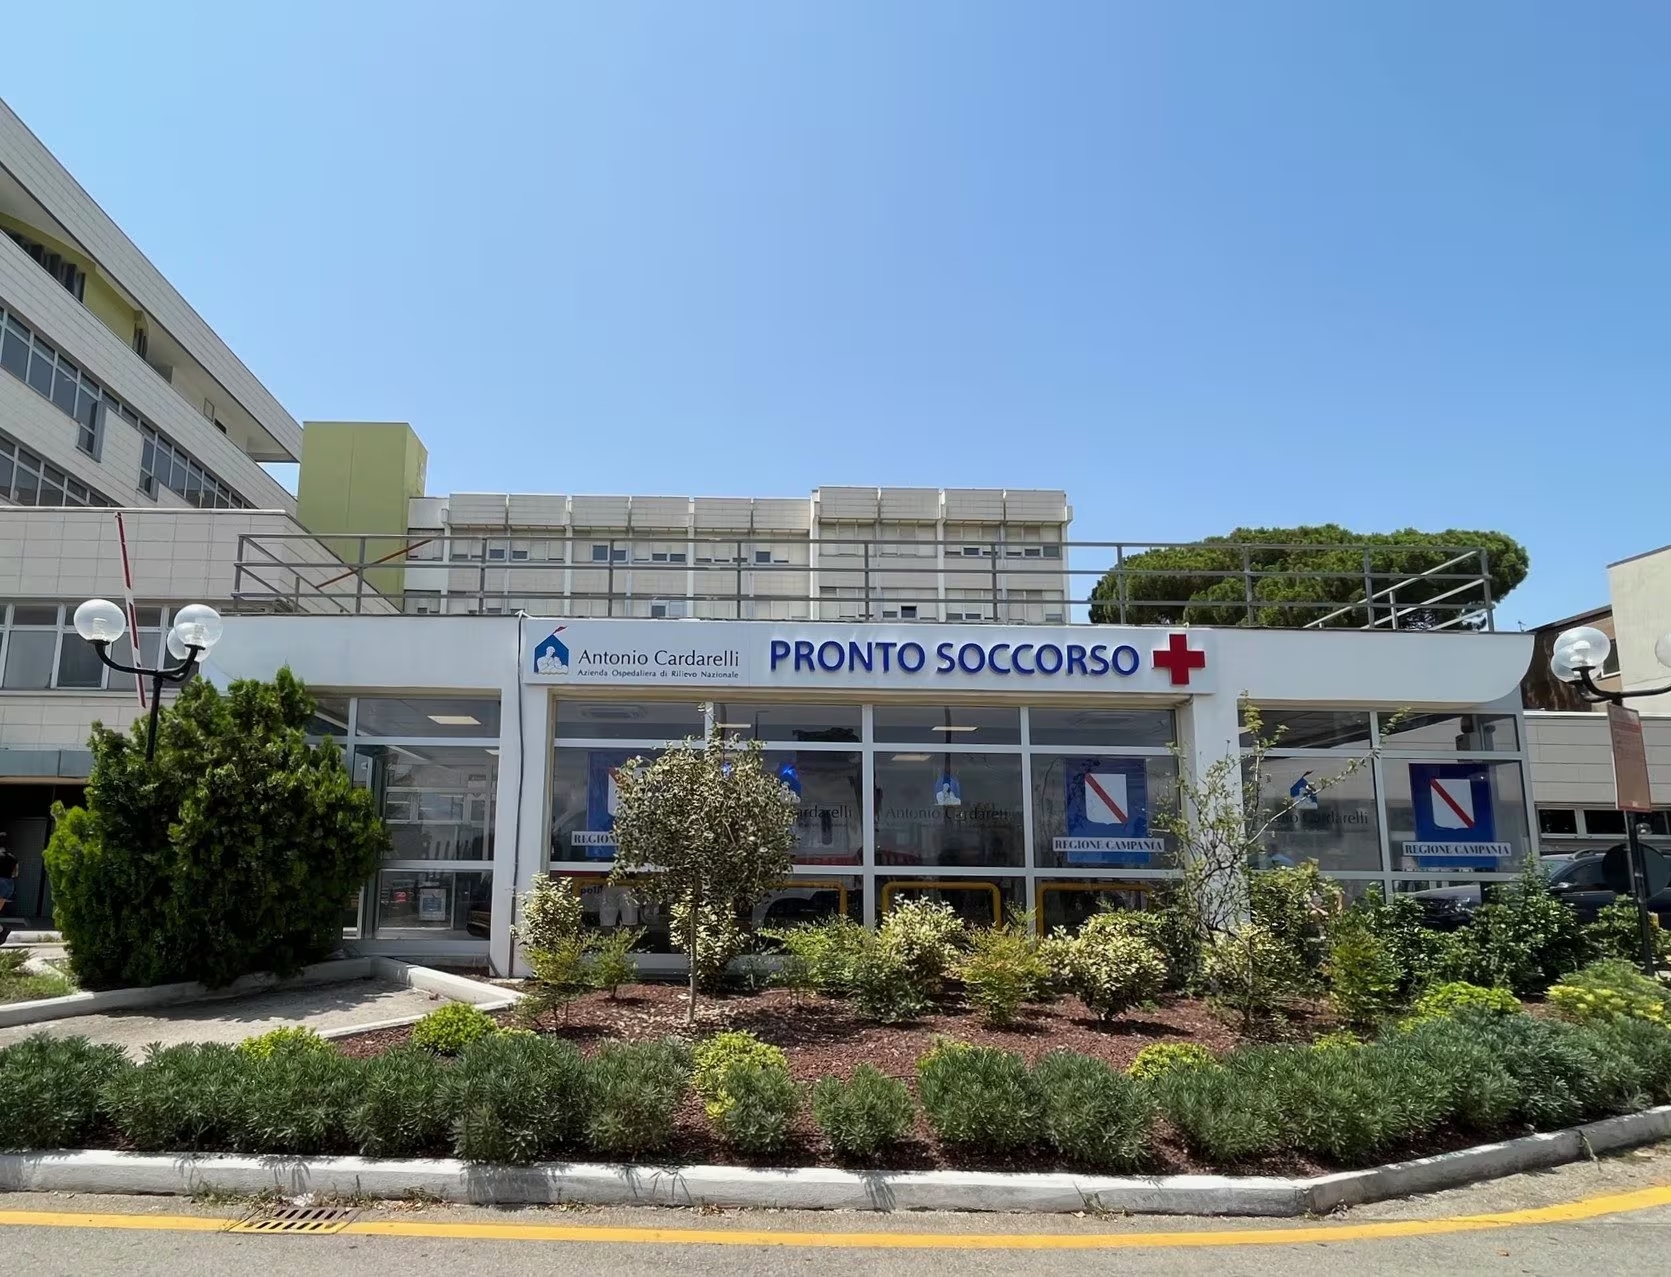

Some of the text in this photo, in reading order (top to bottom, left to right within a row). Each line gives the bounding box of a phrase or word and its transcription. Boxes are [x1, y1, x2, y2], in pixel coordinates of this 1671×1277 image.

[578, 649, 739, 667] Antonio Cardarelli
[770, 640, 1140, 676] PRONTO SOCCORSO
[577, 669, 739, 679] Azienda Ospedaliera di Rilievo Nazionale
[1054, 839, 1162, 851] REGIONE CAMPANIA
[1405, 844, 1509, 855] REGIONE CAMPANIA
